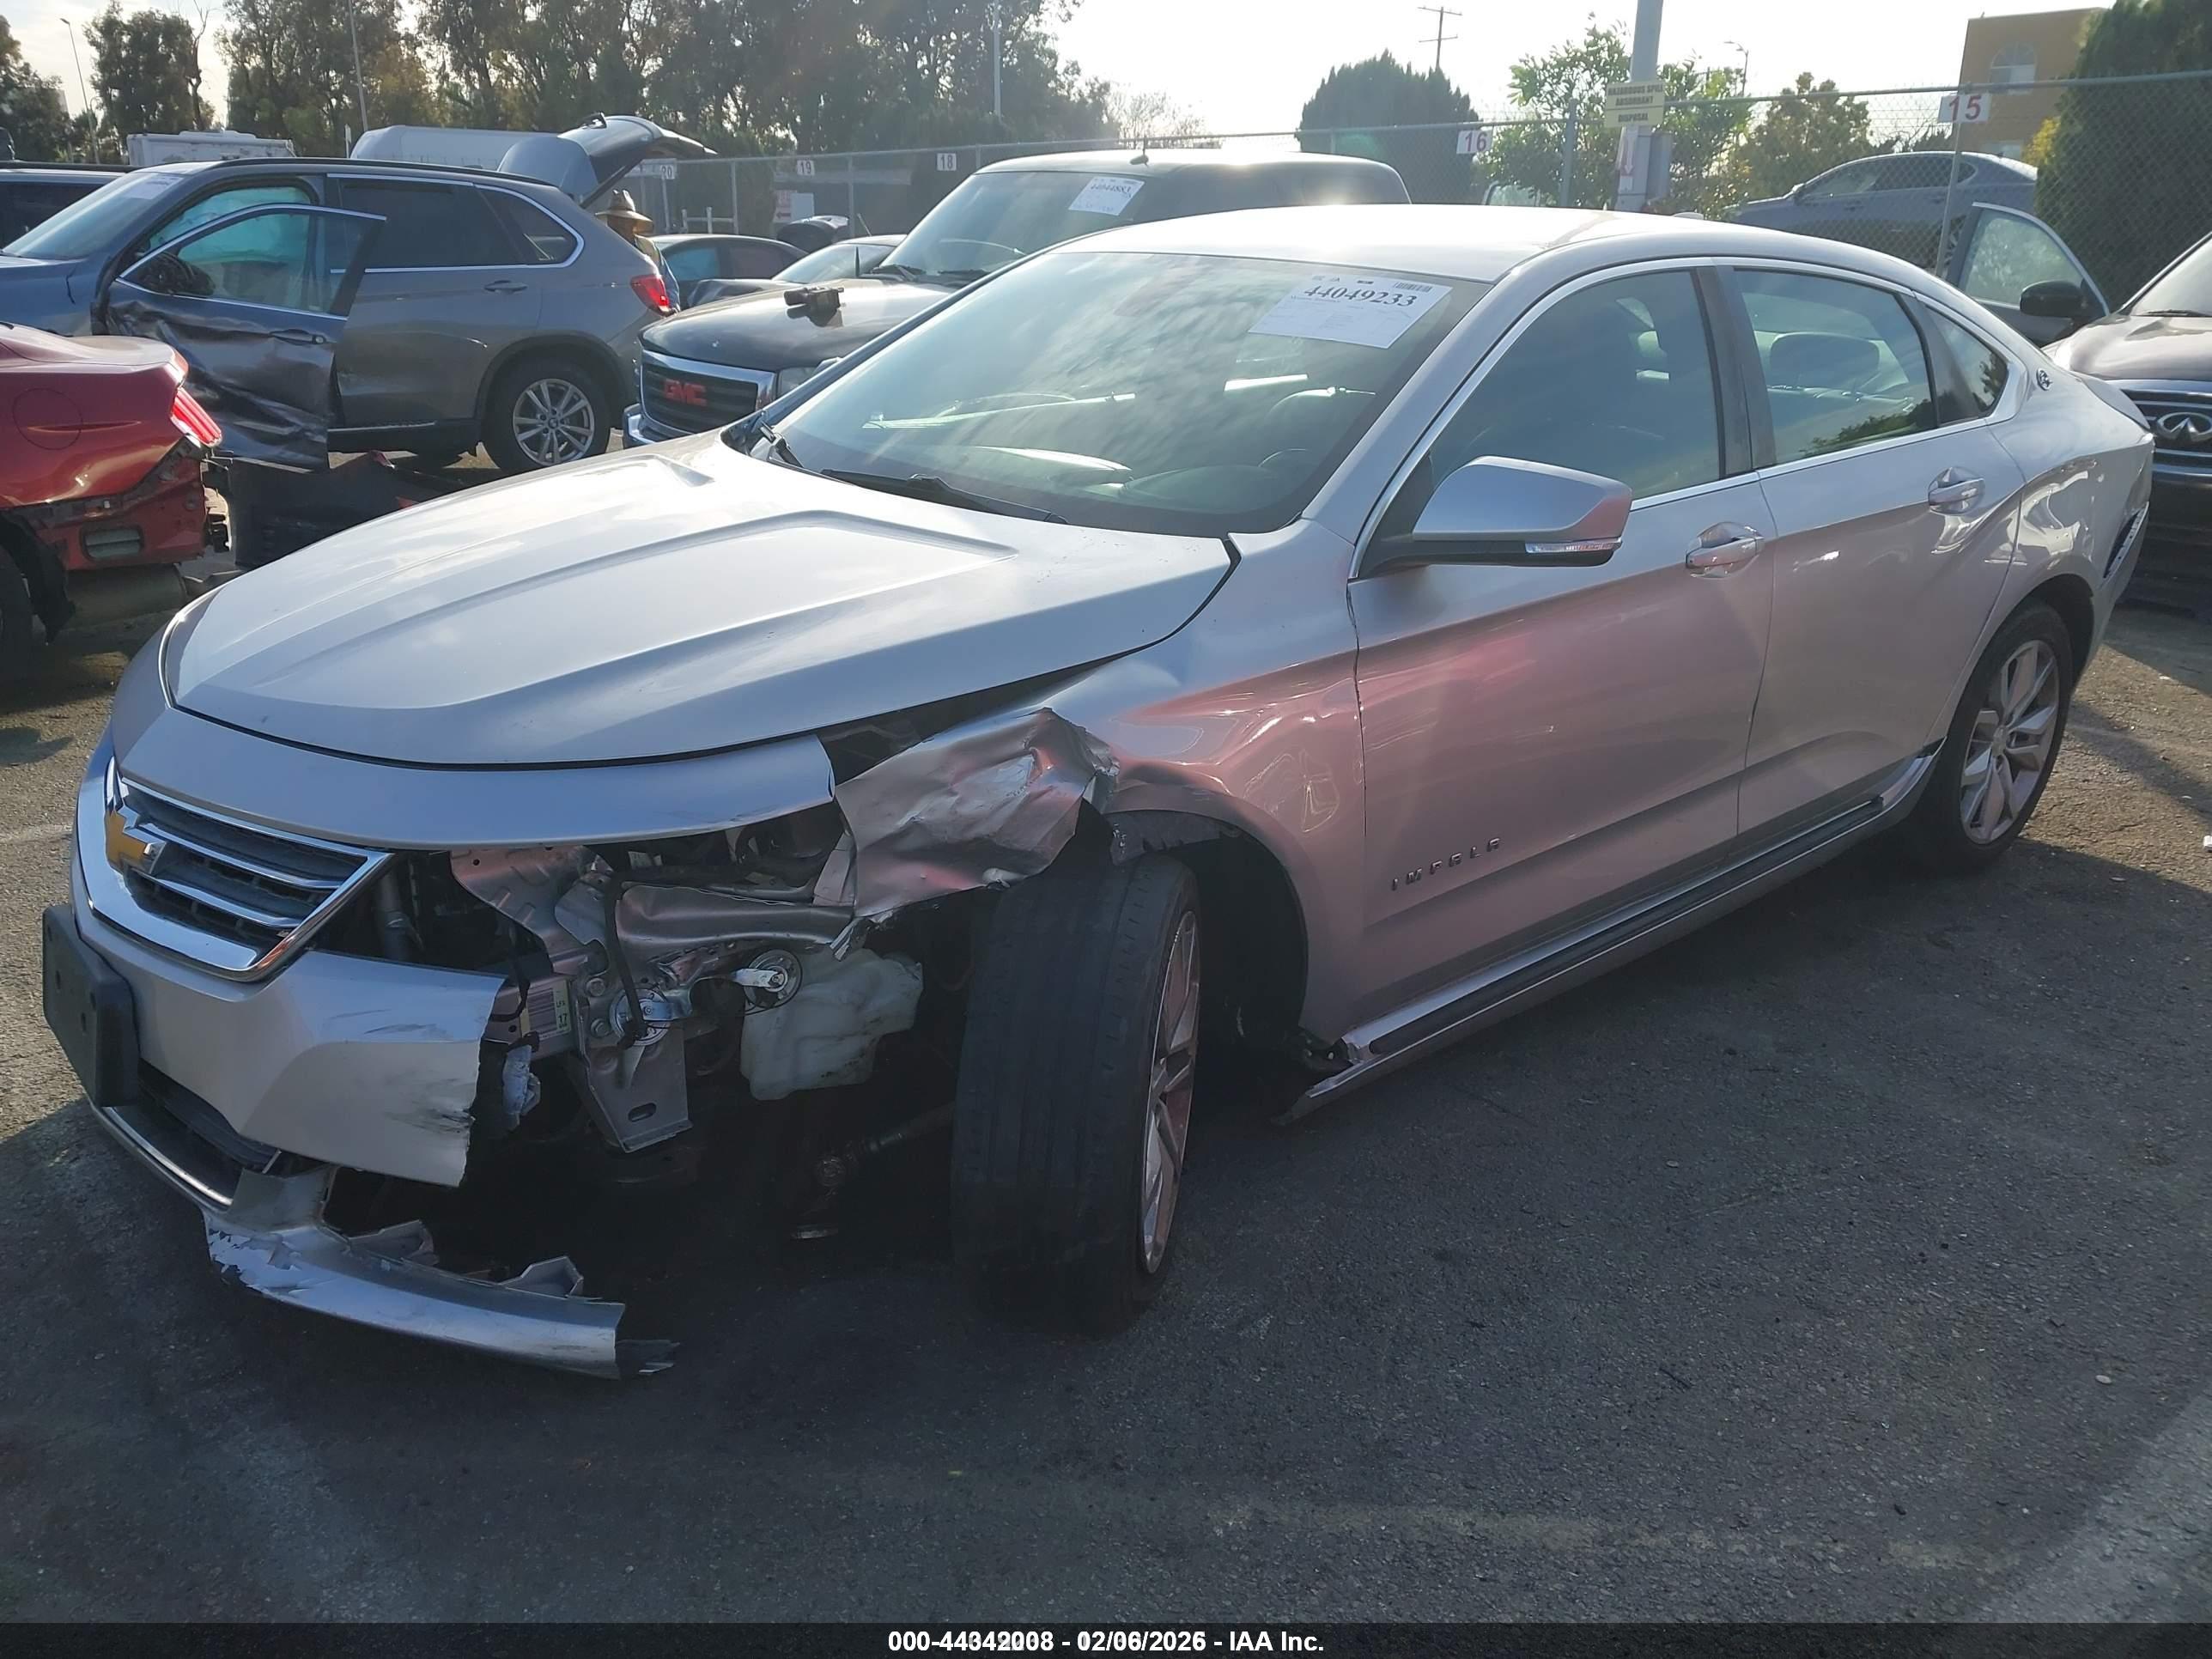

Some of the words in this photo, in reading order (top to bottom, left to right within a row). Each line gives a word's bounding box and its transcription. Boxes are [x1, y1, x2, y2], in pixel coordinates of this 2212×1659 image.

[1948, 94, 1982, 122] 15
[1465, 131, 1488, 152] 16
[660, 166, 673, 179] 20
[799, 160, 811, 174] 19
[940, 155, 953, 169] 18
[1304, 285, 1418, 307] 44049233
[665, 378, 708, 407] GMC
[1391, 836, 1502, 891] IMPALA
